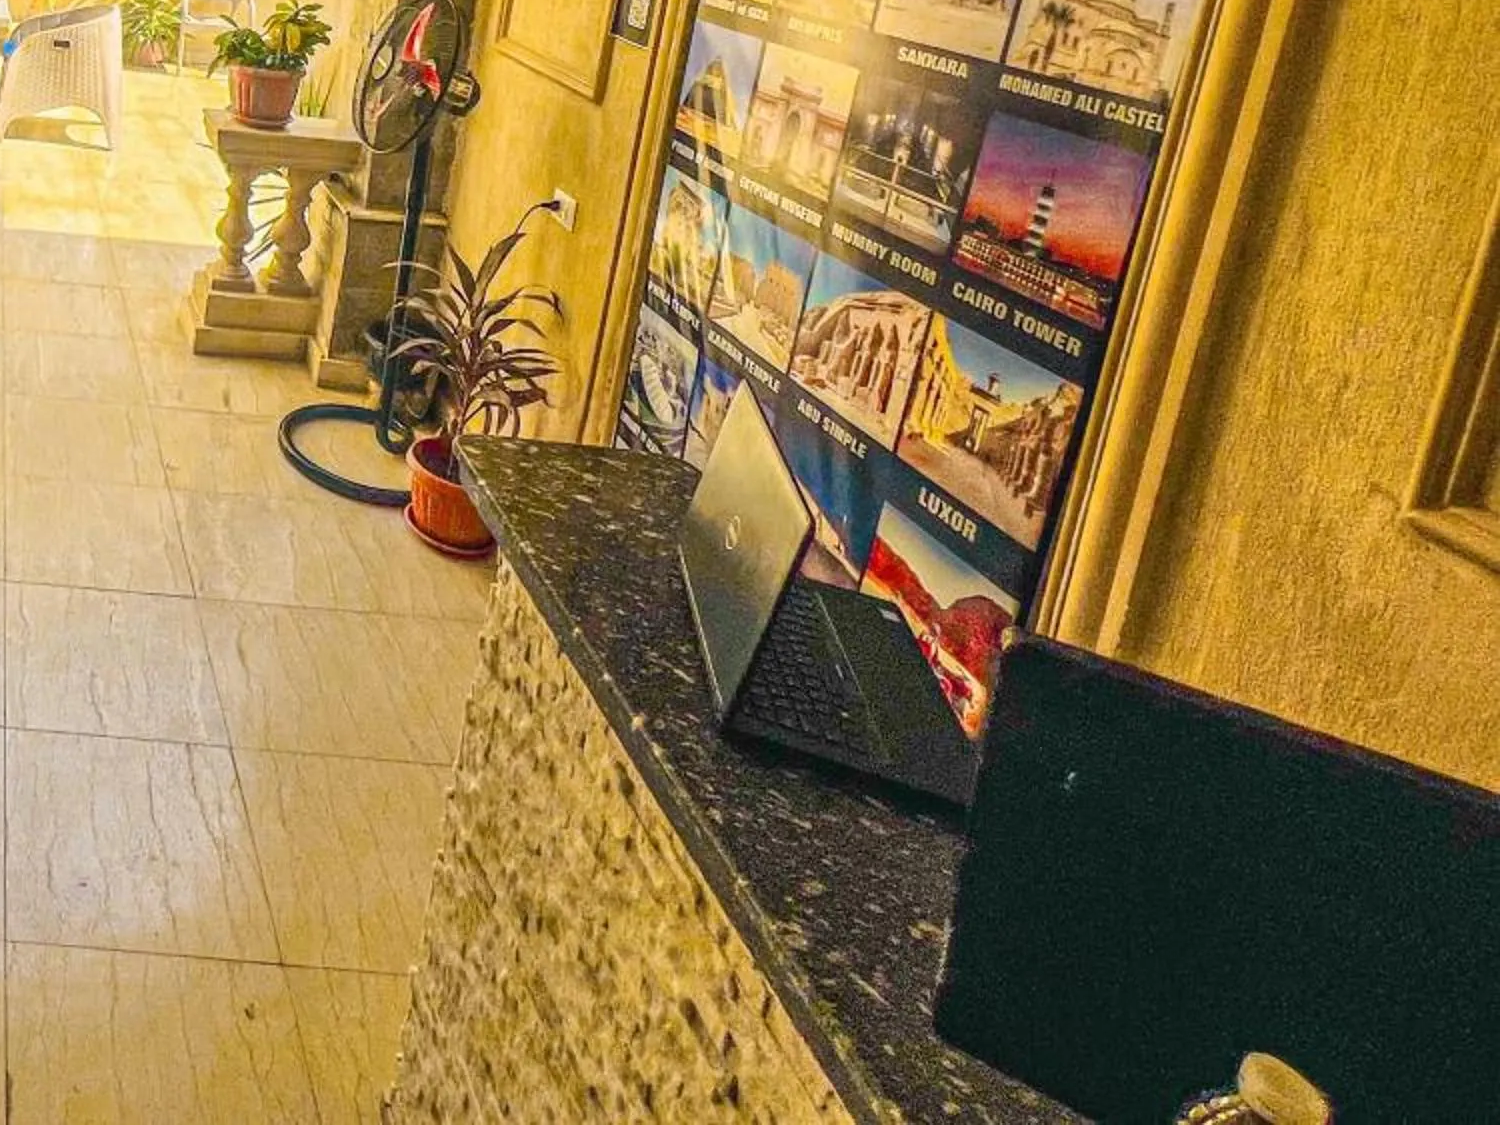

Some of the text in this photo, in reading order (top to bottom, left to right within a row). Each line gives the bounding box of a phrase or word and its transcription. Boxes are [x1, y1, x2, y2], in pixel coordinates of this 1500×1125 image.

[898, 46, 969, 79] SAKKARA
[999, 74, 1166, 134] MOHAMED ALI CASTEL
[831, 222, 938, 287] MUMMY ROOM
[952, 281, 1084, 359] CAIRO TOWER
[743, 355, 781, 394] TEMPLE
[797, 398, 821, 425] ABU
[918, 486, 978, 543] LUXOR
